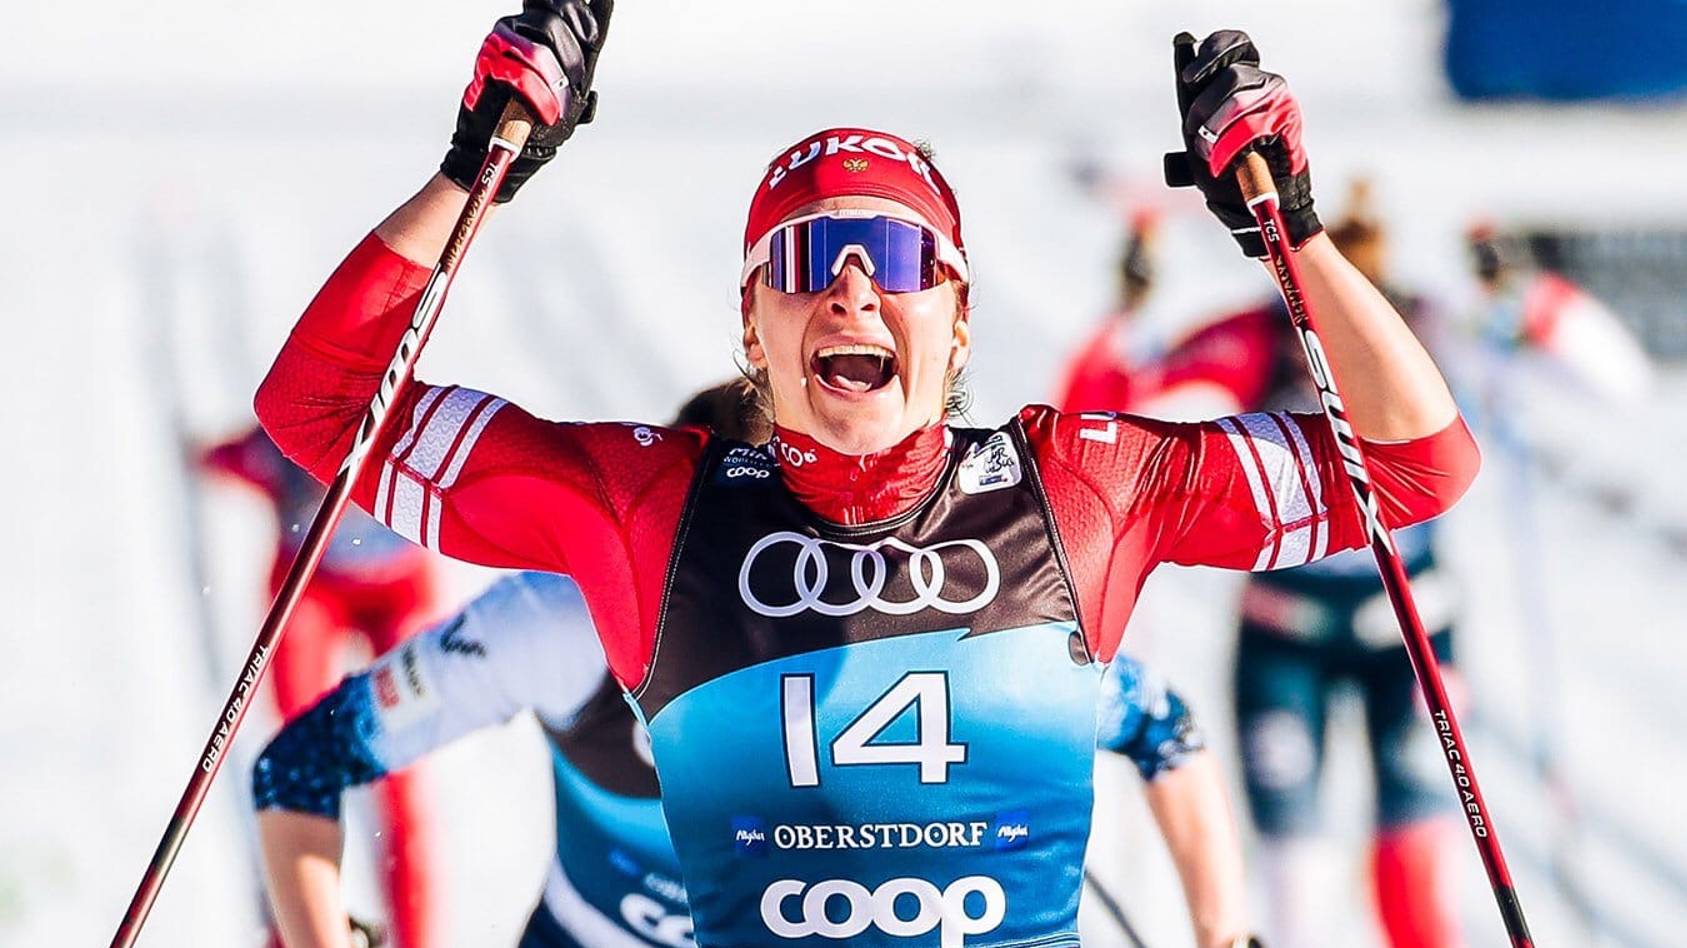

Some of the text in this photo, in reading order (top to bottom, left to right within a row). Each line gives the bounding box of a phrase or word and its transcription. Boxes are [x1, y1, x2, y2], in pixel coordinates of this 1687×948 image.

[726, 466, 770, 479] coop
[240, 648, 268, 696] TRIAC
[202, 723, 227, 772] AERO
[780, 670, 968, 787] 14
[1434, 710, 1460, 758] TRIAC
[1462, 791, 1487, 837] AERO
[773, 822, 988, 849] OBERSTDORF
[760, 876, 1006, 948] coop
